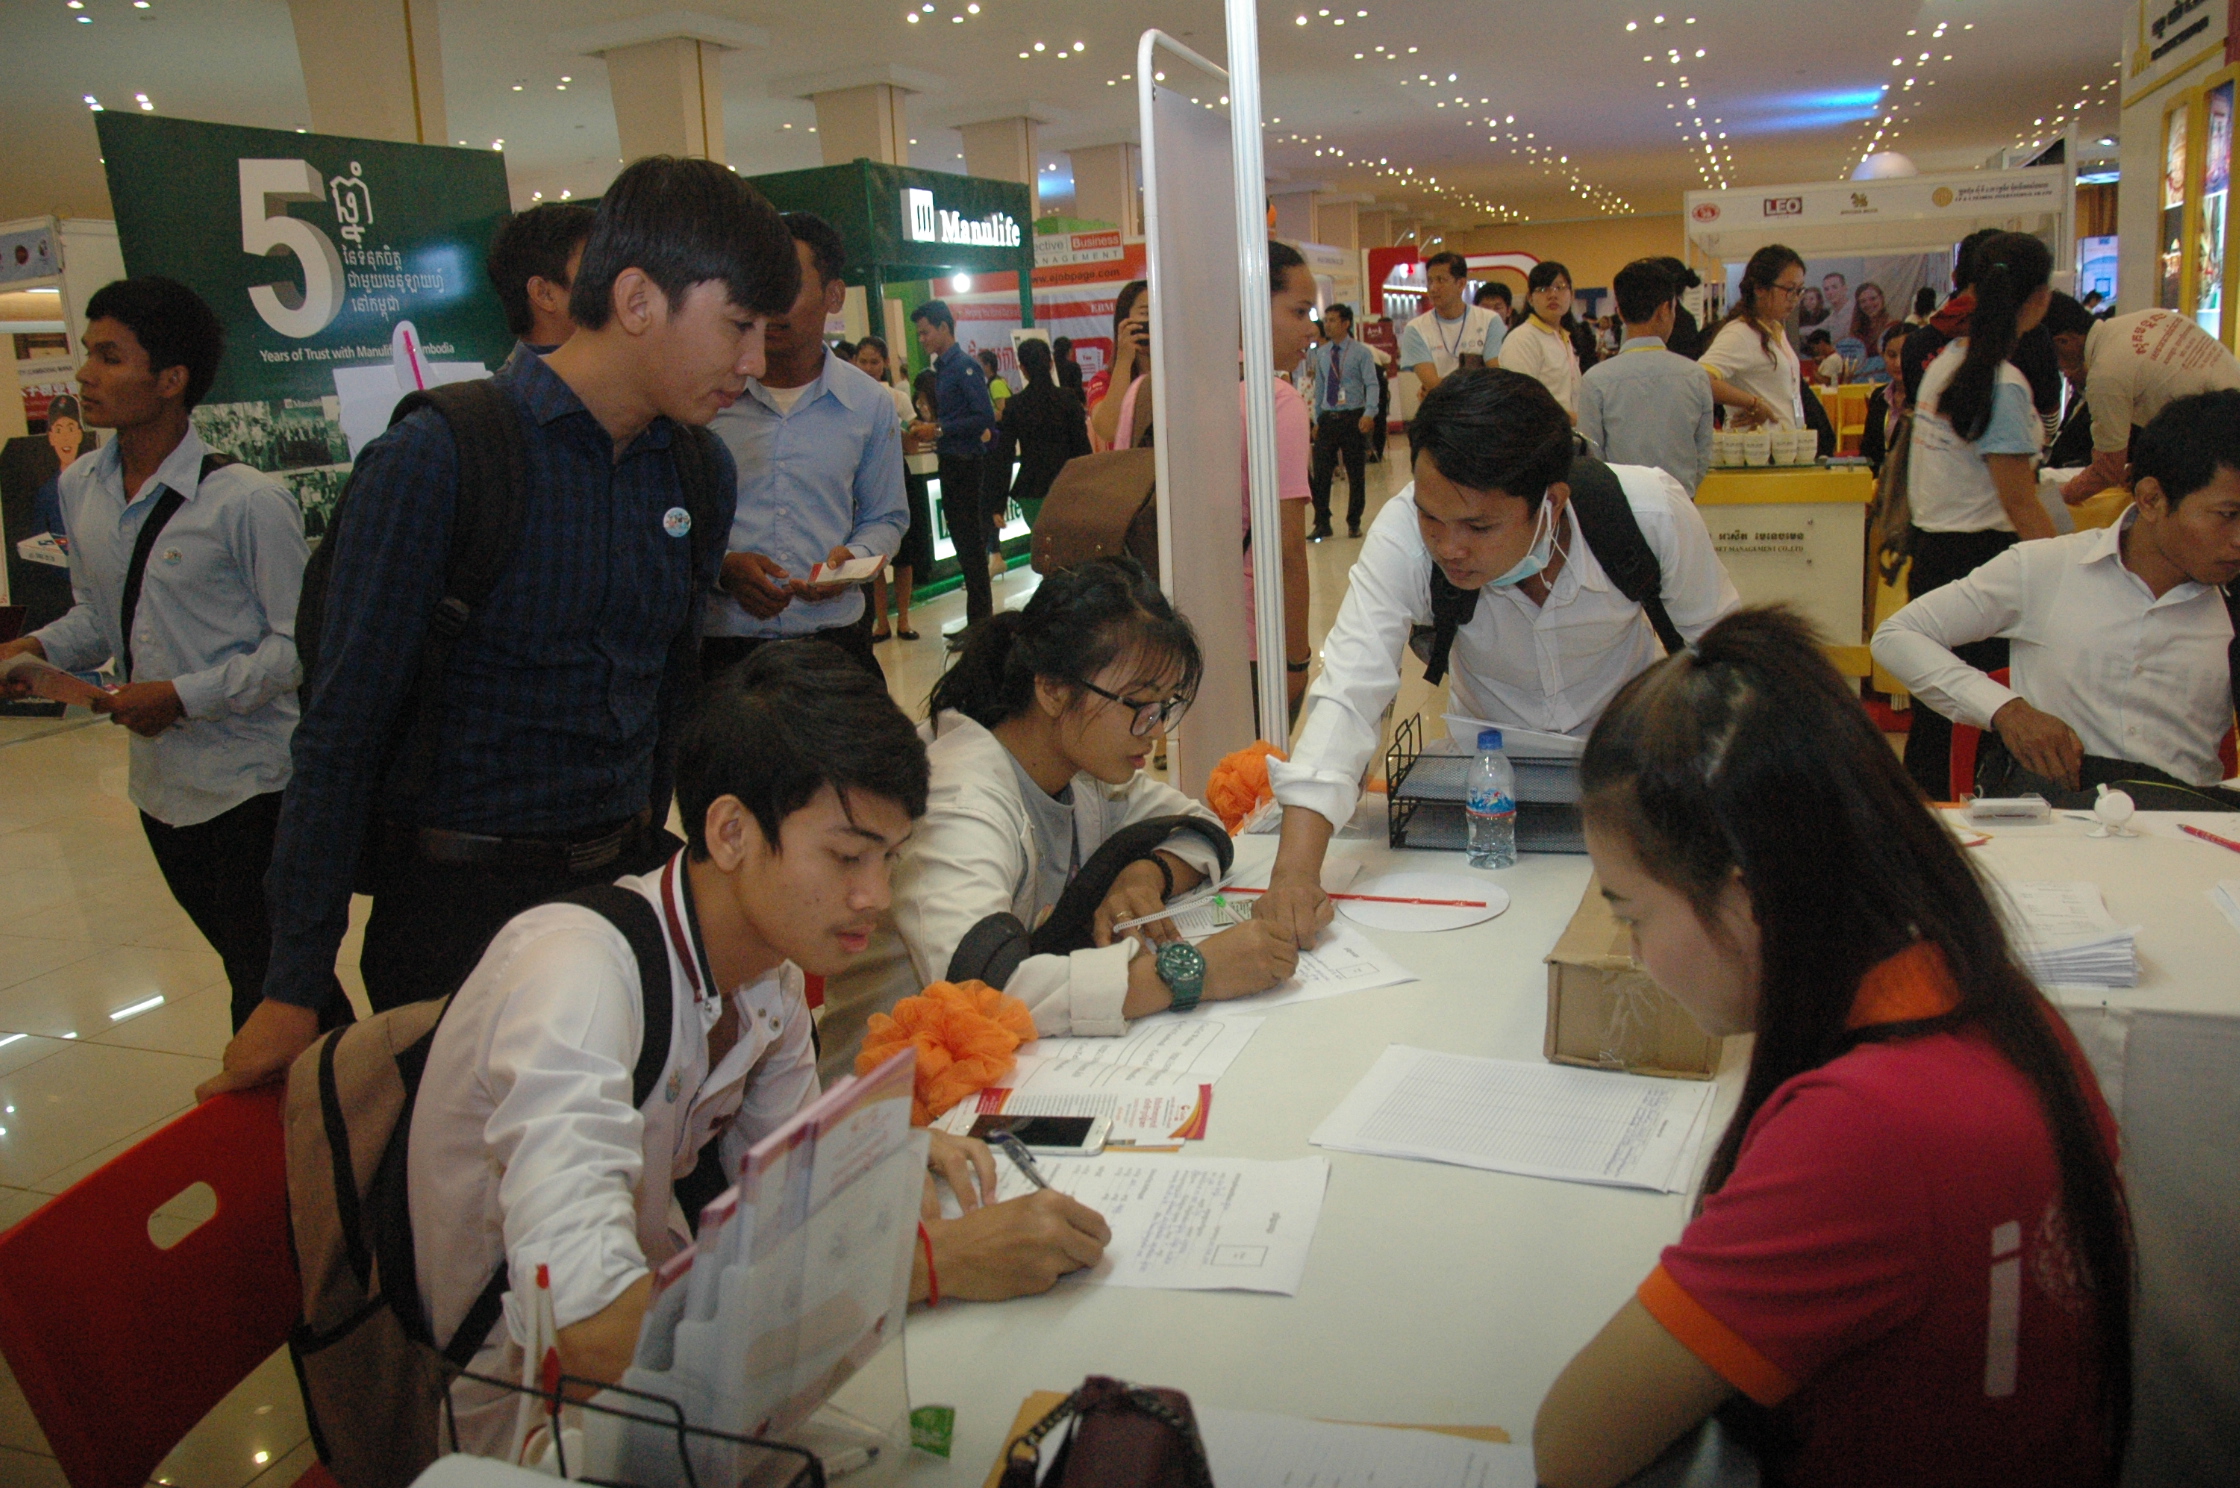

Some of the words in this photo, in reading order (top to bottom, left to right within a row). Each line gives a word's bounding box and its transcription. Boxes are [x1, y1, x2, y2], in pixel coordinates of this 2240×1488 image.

[1766, 201, 1800, 213] LEO
[940, 209, 1020, 247] Manulife
[239, 158, 345, 338] 5
[1072, 236, 1119, 249] Business
[1034, 250, 1118, 265] NAGEMENT
[1031, 269, 1120, 284] ww.ejobpage.com
[259, 348, 290, 362] Years
[292, 348, 303, 361] of
[306, 346, 331, 360] Trust
[333, 345, 355, 358] with
[357, 343, 394, 357] Manulif
[422, 342, 455, 355] mbodia
